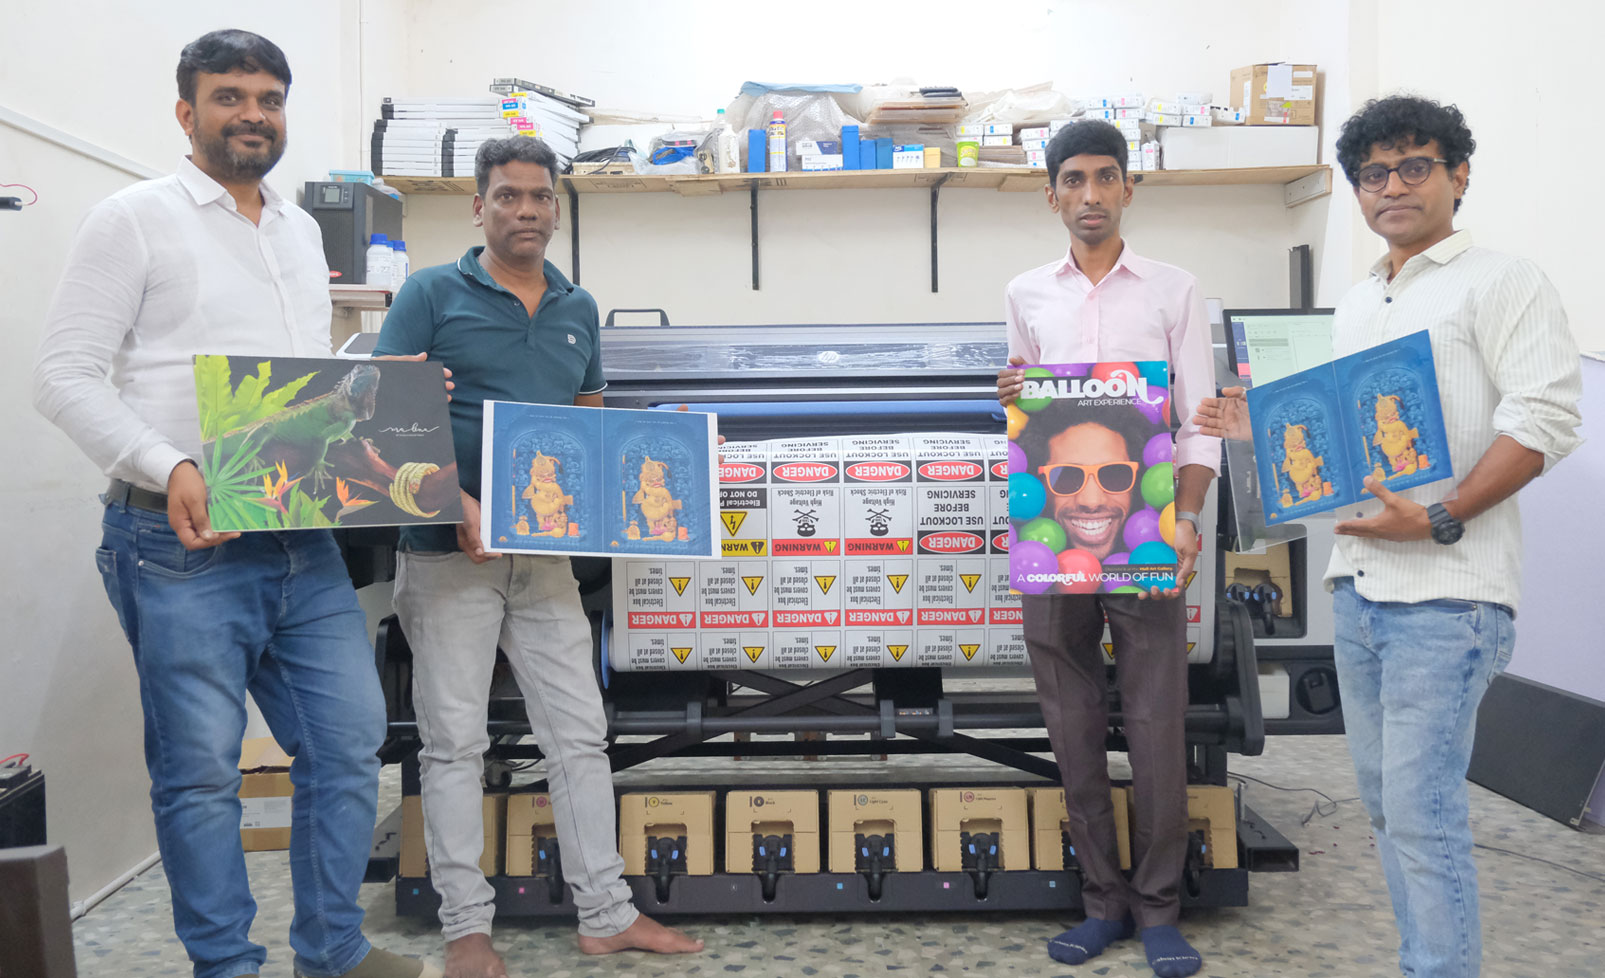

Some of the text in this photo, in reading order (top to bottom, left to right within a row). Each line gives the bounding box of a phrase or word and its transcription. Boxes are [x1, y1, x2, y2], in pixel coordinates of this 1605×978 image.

[1020, 369, 1164, 404] BALLOON
[1094, 398, 1141, 406] EXPERIENCE
[718, 467, 756, 477] DANGE
[782, 467, 829, 476] DANGER
[854, 466, 901, 476] DANGER
[927, 465, 974, 475] DANGER
[927, 490, 975, 498] SERVICING
[810, 498, 822, 506] High
[862, 498, 895, 506] High Voltage
[933, 503, 969, 511] BEFORE
[920, 517, 983, 525] USE LOCKOUT
[928, 537, 975, 547] DANGER
[721, 543, 748, 551] WARN
[775, 543, 821, 551] WARNING
[848, 543, 894, 551] WARNING
[647, 578, 662, 586] closed
[713, 577, 719, 585] at
[720, 577, 735, 585] closed
[786, 576, 791, 584] at
[792, 576, 808, 584] closed
[865, 575, 880, 584] closed
[938, 575, 953, 583] closed
[1017, 571, 1174, 585] A COLORFUL WORLD OF FUN
[635, 588, 646, 596] must
[701, 587, 706, 596] be
[708, 587, 719, 595] must
[773, 587, 779, 595] be
[846, 586, 851, 595] be
[919, 585, 924, 594] be
[926, 585, 936, 593] must
[991, 584, 997, 592] be
[628, 588, 634, 597] be
[632, 598, 663, 607] Electrical box
[714, 597, 735, 606] Electrical
[777, 597, 808, 605] Electrical box
[849, 596, 880, 604] Electrical box
[922, 595, 953, 603] Electrical box
[704, 614, 749, 624] DANGER
[776, 613, 821, 622] DANGER
[849, 612, 893, 621] DANGER
[921, 611, 966, 620] DANGER
[993, 610, 1023, 620] NGER
[632, 615, 676, 624] DANGER
[865, 646, 880, 654] closed
[937, 645, 952, 653] closed
[1009, 644, 1024, 652] closed
[630, 658, 636, 666] be
